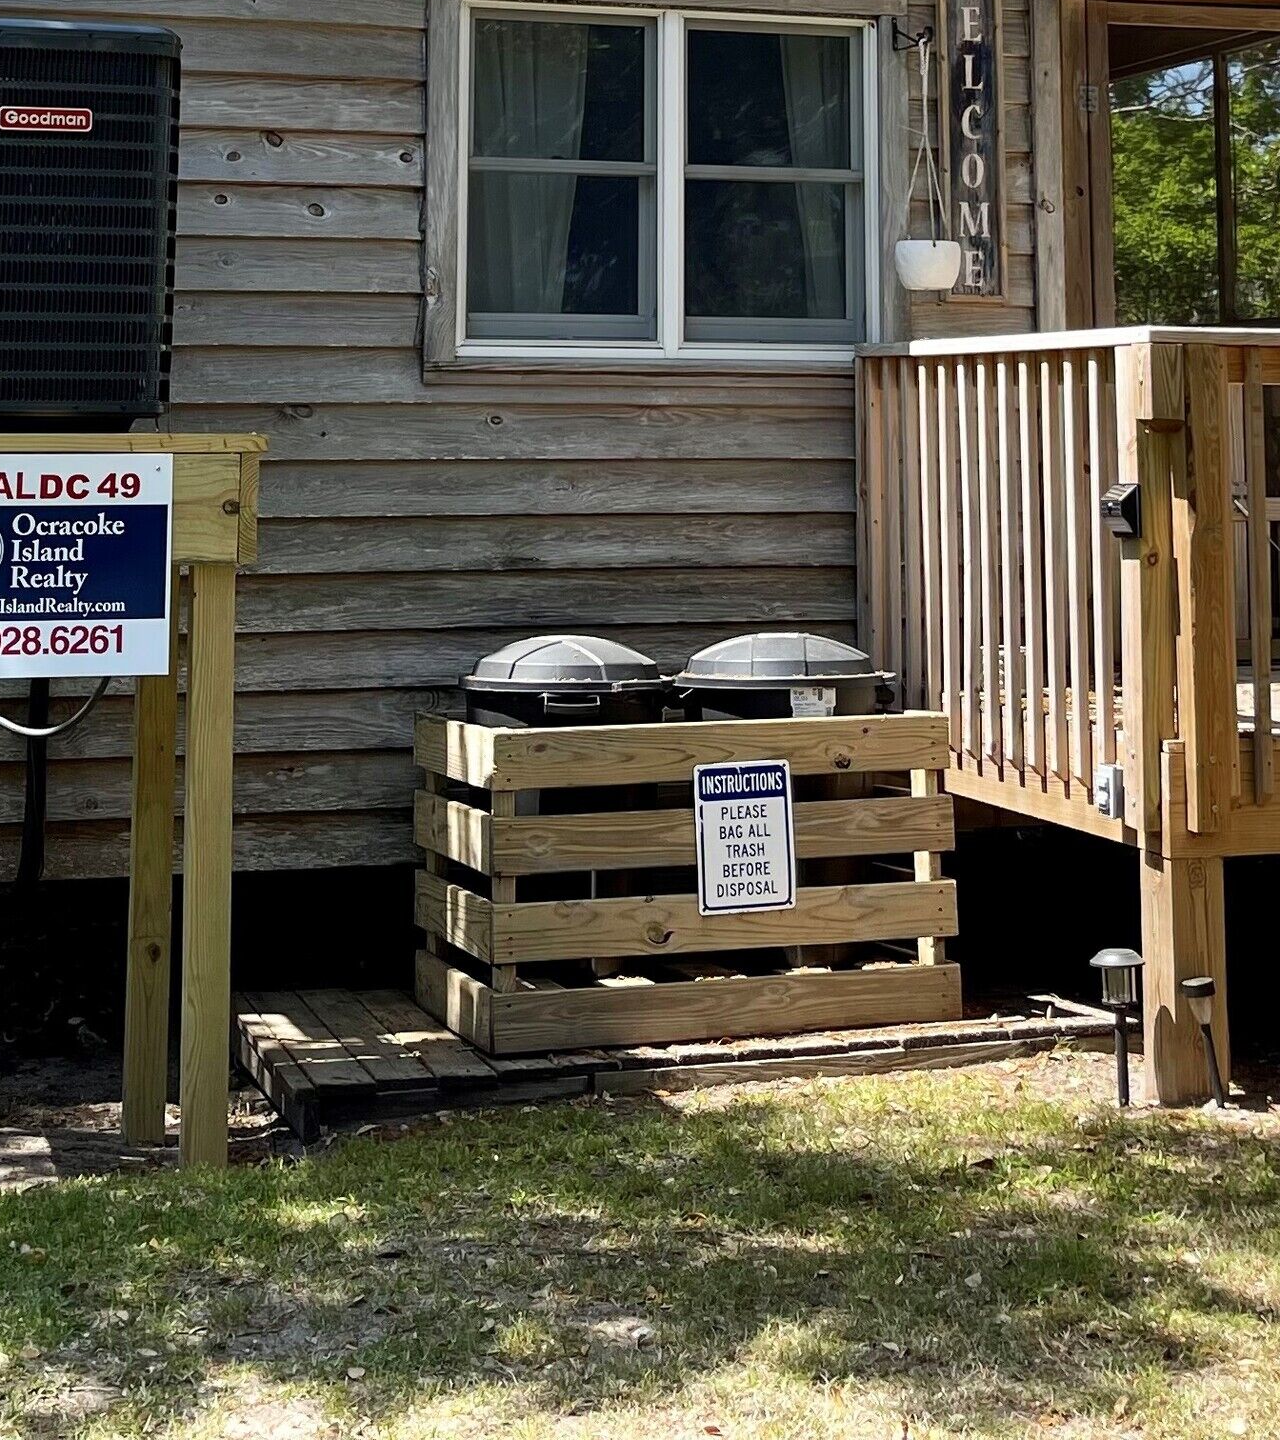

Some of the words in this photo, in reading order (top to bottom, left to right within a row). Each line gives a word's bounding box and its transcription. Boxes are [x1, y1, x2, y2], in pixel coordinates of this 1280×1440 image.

[5, 110, 86, 126] Goodman
[97, 473, 141, 498] 49
[12, 512, 125, 536] Ocracoke
[11, 539, 84, 562] Island
[10, 566, 88, 594] Realty
[701, 771, 783, 795] INSTRUCTIONS
[721, 804, 768, 820] PLEASE
[720, 825, 743, 840] BAG
[748, 824, 771, 838] ALL
[726, 842, 765, 858] TRASH
[723, 861, 771, 878] BEFORE
[717, 880, 778, 898] DISPOSAL
